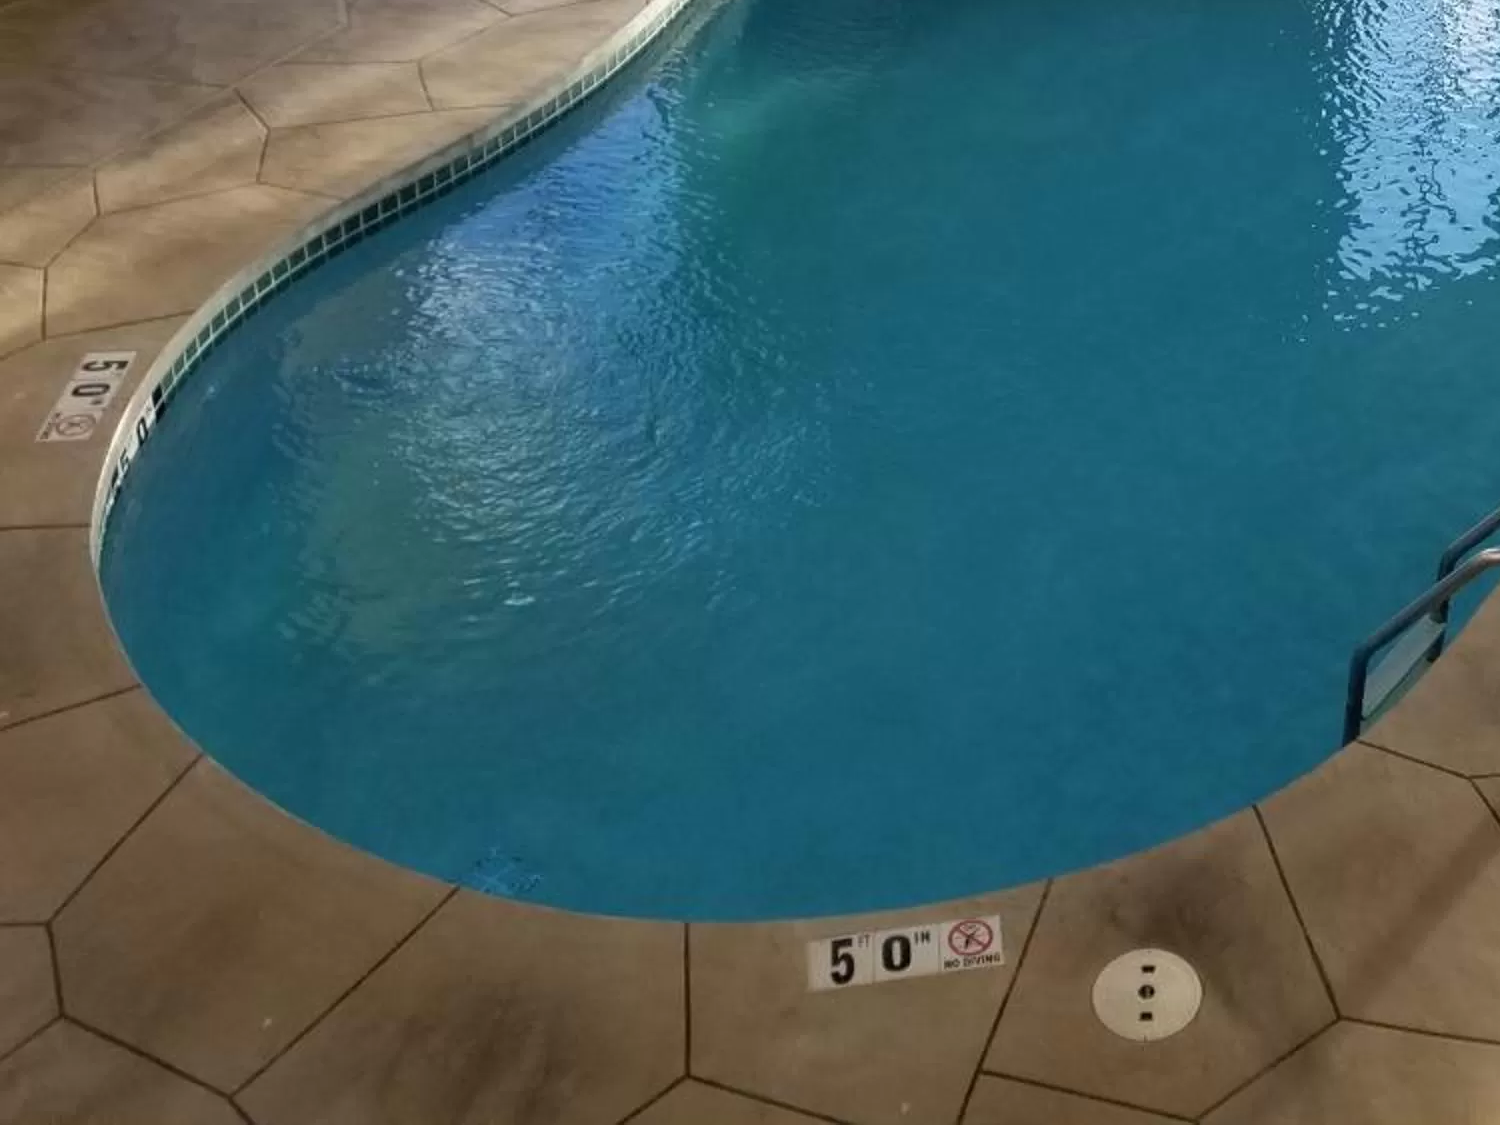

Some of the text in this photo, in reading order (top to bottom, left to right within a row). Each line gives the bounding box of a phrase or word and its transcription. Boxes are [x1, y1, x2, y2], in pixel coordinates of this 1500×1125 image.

[831, 937, 855, 986] 5
[881, 934, 912, 973] 0
[963, 952, 1001, 968] DIVING
